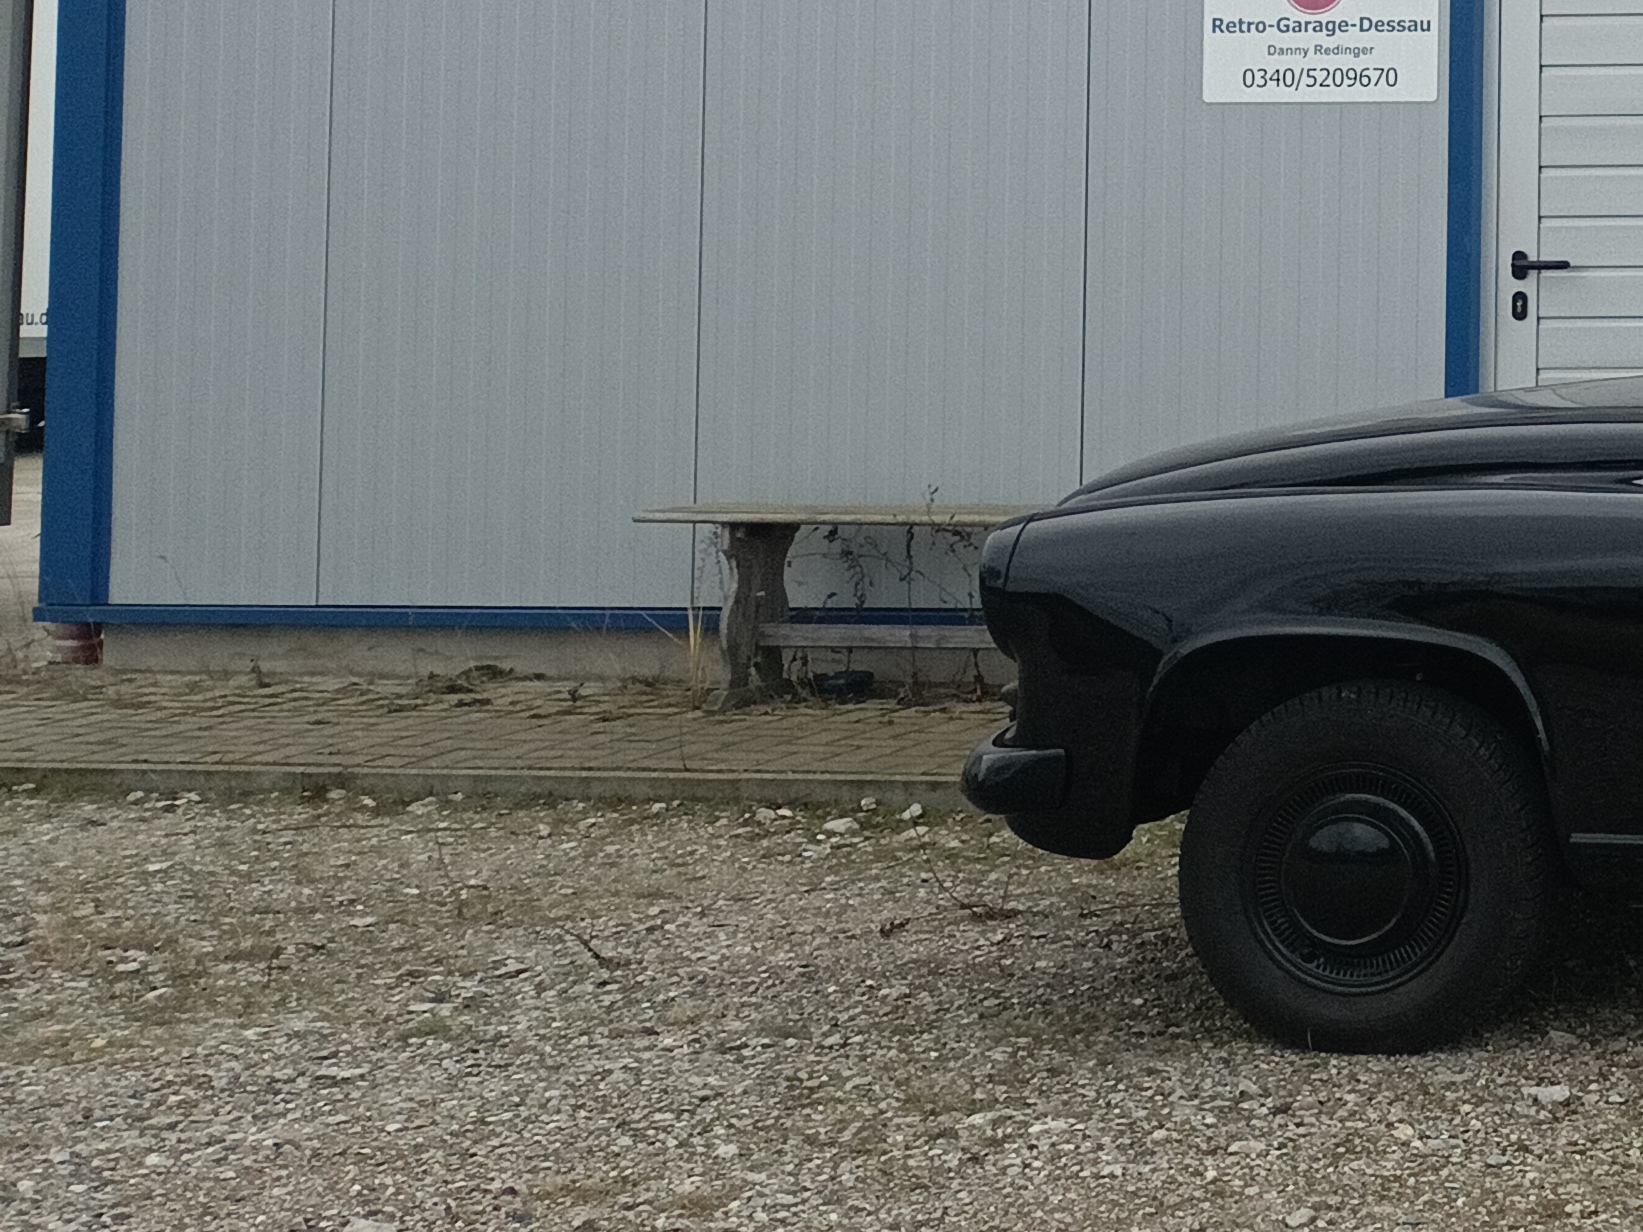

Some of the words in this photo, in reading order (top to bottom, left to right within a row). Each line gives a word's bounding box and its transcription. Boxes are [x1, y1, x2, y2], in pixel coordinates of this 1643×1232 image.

[1211, 17, 1432, 37] Retro-Garage-Dessau
[1267, 44, 1310, 58] Danny
[1313, 44, 1375, 58] Redinger
[1242, 67, 1398, 91] 0340/5209670
